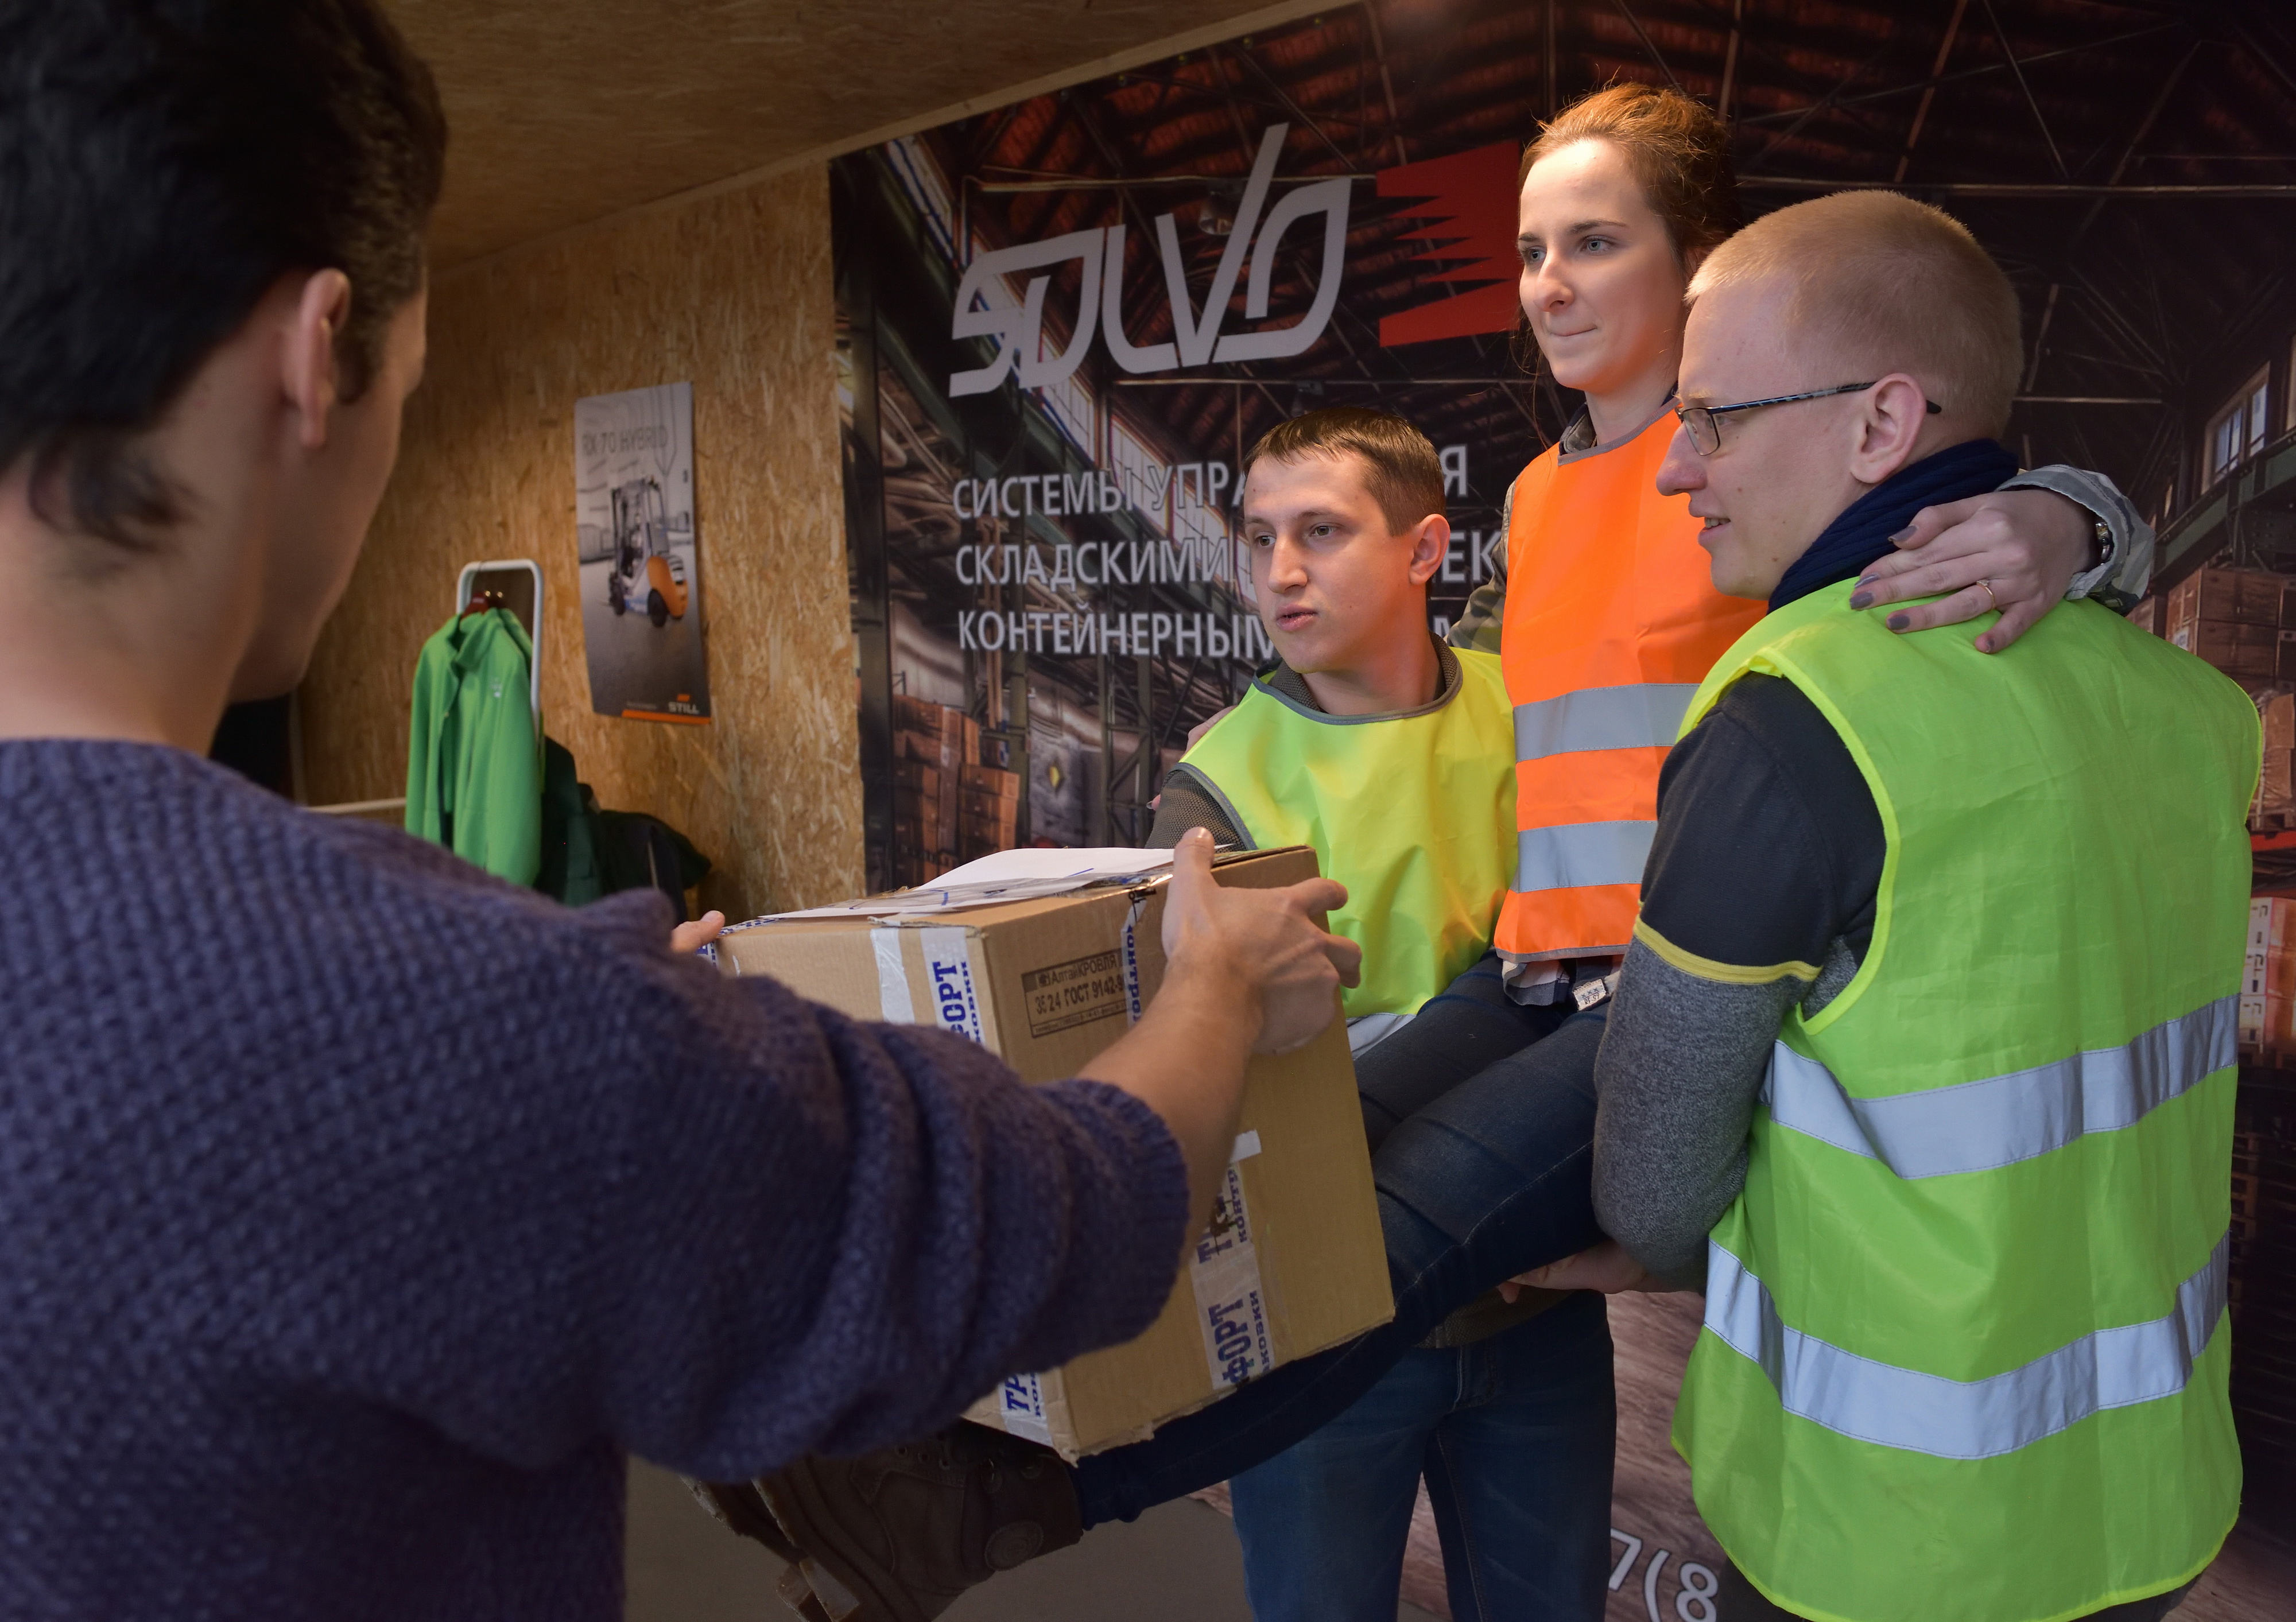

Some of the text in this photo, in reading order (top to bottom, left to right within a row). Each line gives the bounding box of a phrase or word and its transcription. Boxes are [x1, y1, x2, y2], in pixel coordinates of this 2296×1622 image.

[953, 467, 1135, 518] СИСТЕМЫ
[955, 537, 1230, 593] СКЛАДСКИМИ
[958, 603, 1275, 661] КОНТЕЙНЕРНЫМ
[1064, 983, 1090, 1007] ГОСТ
[1091, 973, 1124, 999] 9142-9
[1208, 1298, 1255, 1383] ФОРТ
